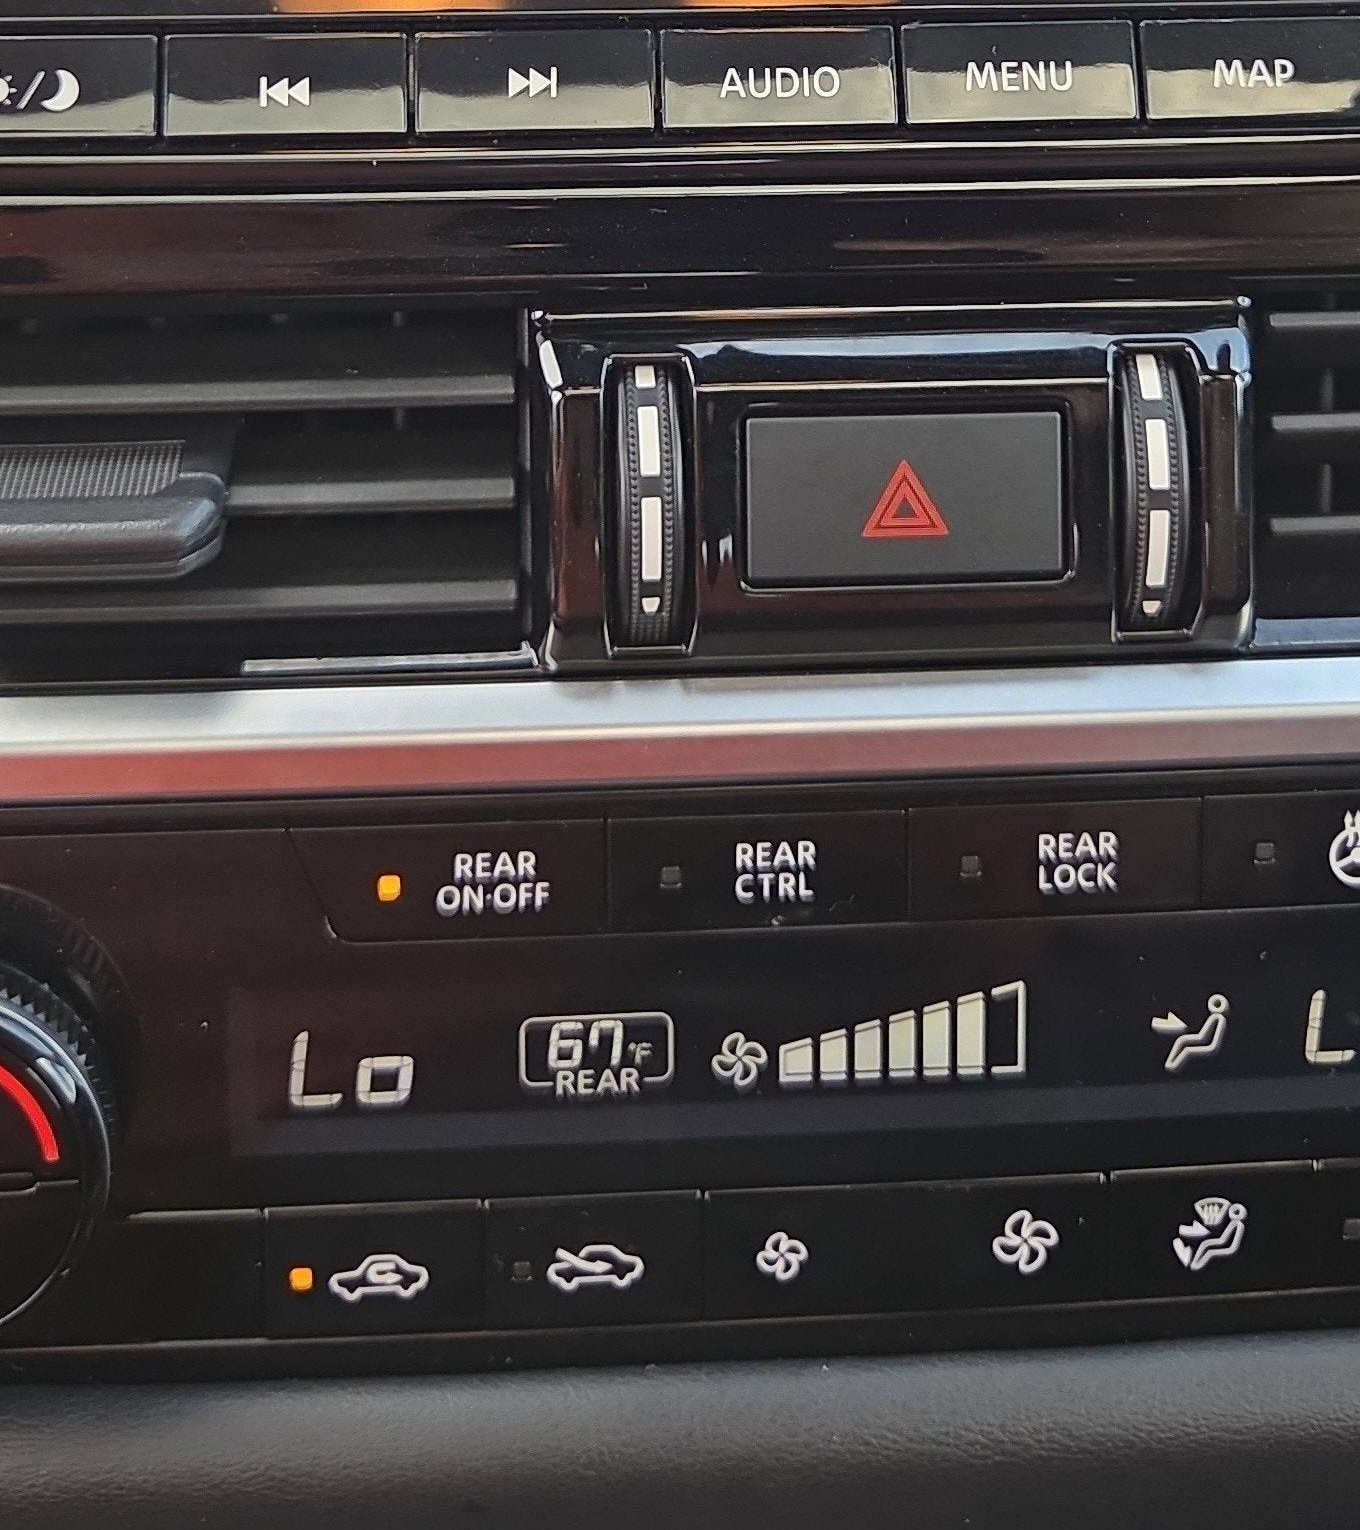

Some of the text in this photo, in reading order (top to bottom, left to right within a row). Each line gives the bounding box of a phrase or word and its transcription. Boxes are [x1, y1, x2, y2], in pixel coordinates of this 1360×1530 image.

[719, 66, 841, 99] AUDIO
[965, 60, 1074, 92] MENU
[1212, 58, 1296, 89] MAP
[735, 840, 817, 870] REAR
[1037, 831, 1119, 861] REAR
[453, 850, 538, 881] REAR
[1037, 861, 1118, 893] LOCK
[735, 871, 815, 902] CTRL
[555, 1067, 640, 1097] REAR
